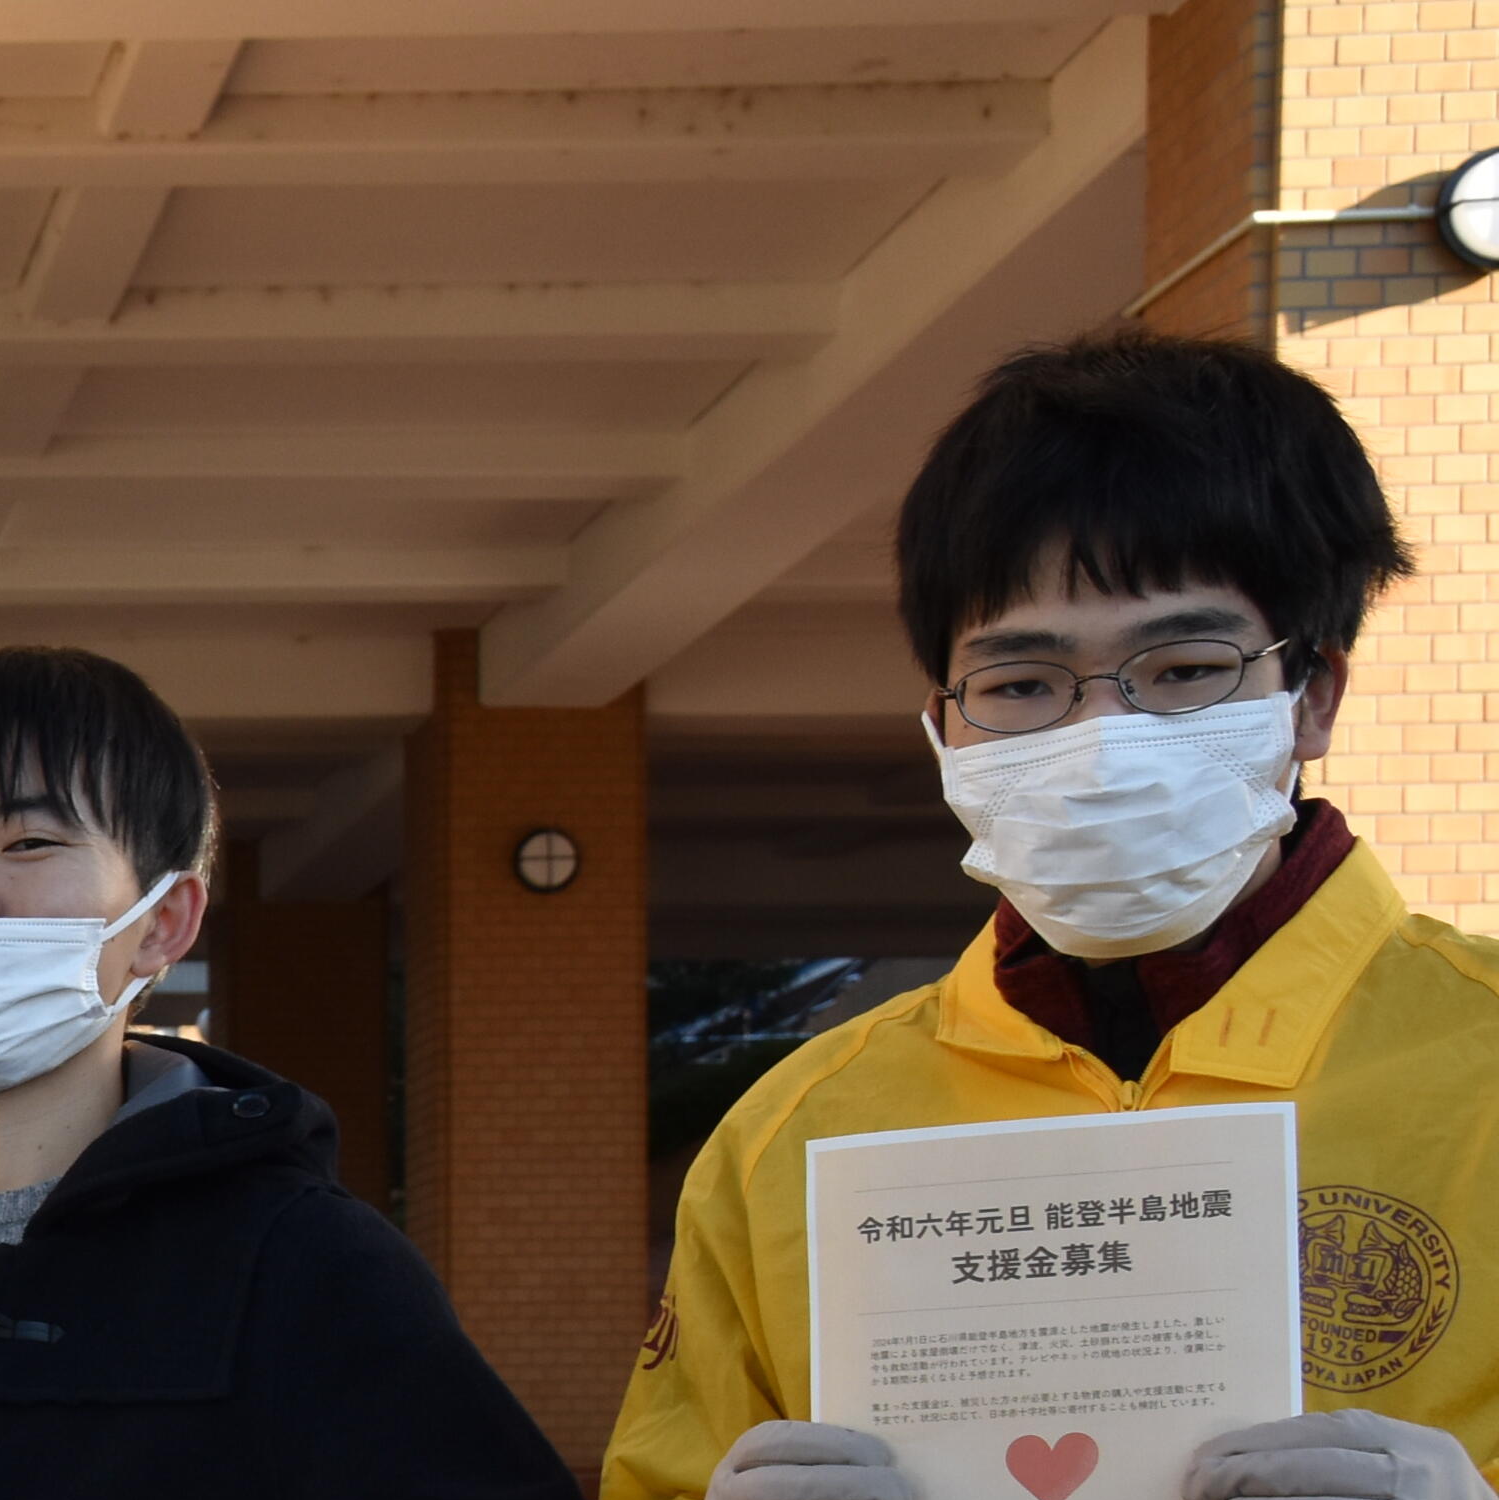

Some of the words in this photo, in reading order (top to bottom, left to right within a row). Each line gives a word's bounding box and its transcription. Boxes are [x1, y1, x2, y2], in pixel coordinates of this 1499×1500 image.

[857, 1206, 1034, 1244] 令和六年元旦
[1045, 1190, 1231, 1230] 能登半島地震
[952, 1240, 1132, 1284] 支援金募集
[1318, 1192, 1451, 1290] UNIVERSITY
[1306, 1333, 1364, 1362] 1926
[1301, 1361, 1336, 1383] OYA
[1342, 1357, 1403, 1386] JAPAN
